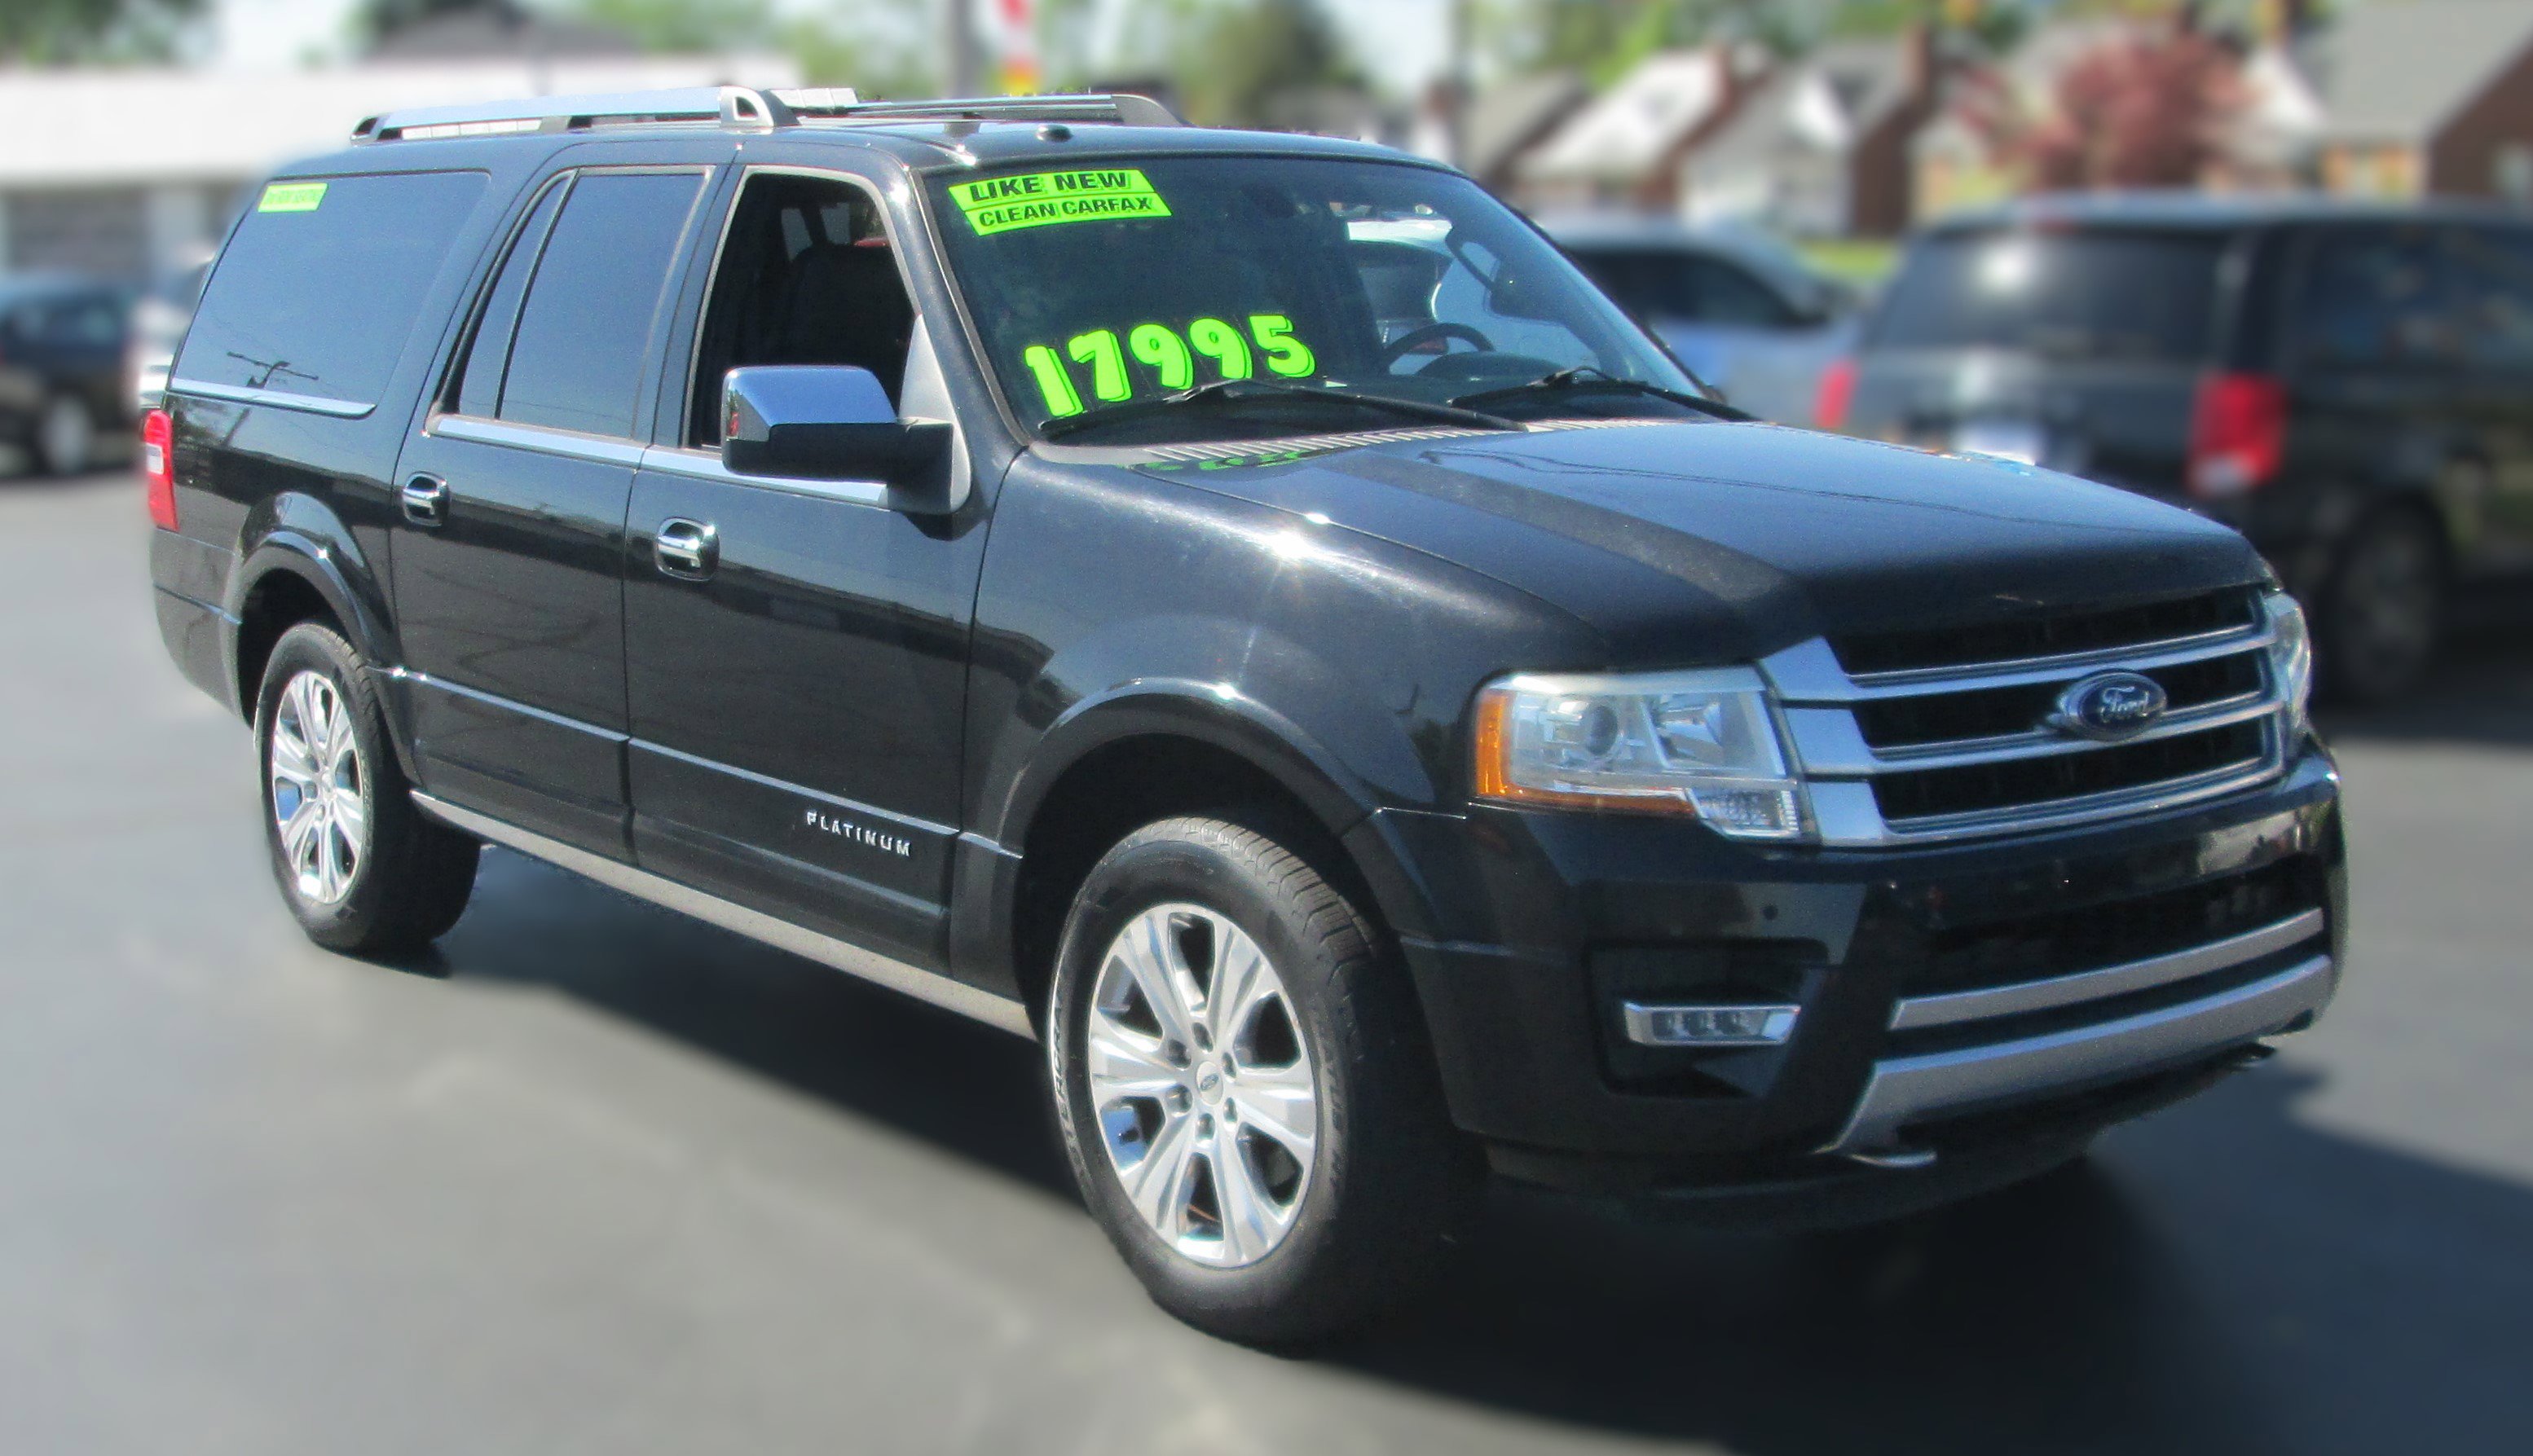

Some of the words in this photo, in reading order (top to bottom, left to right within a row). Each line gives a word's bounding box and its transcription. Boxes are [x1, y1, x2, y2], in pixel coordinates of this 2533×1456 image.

[969, 176, 1044, 202] LIKE
[1053, 172, 1128, 191] NEW
[979, 203, 1057, 227] CLEAN
[1062, 196, 1152, 216] CARFAX
[1024, 315, 1315, 417] 17995
[2099, 685, 2150, 724] Ford
[806, 811, 911, 857] PLATINUM
